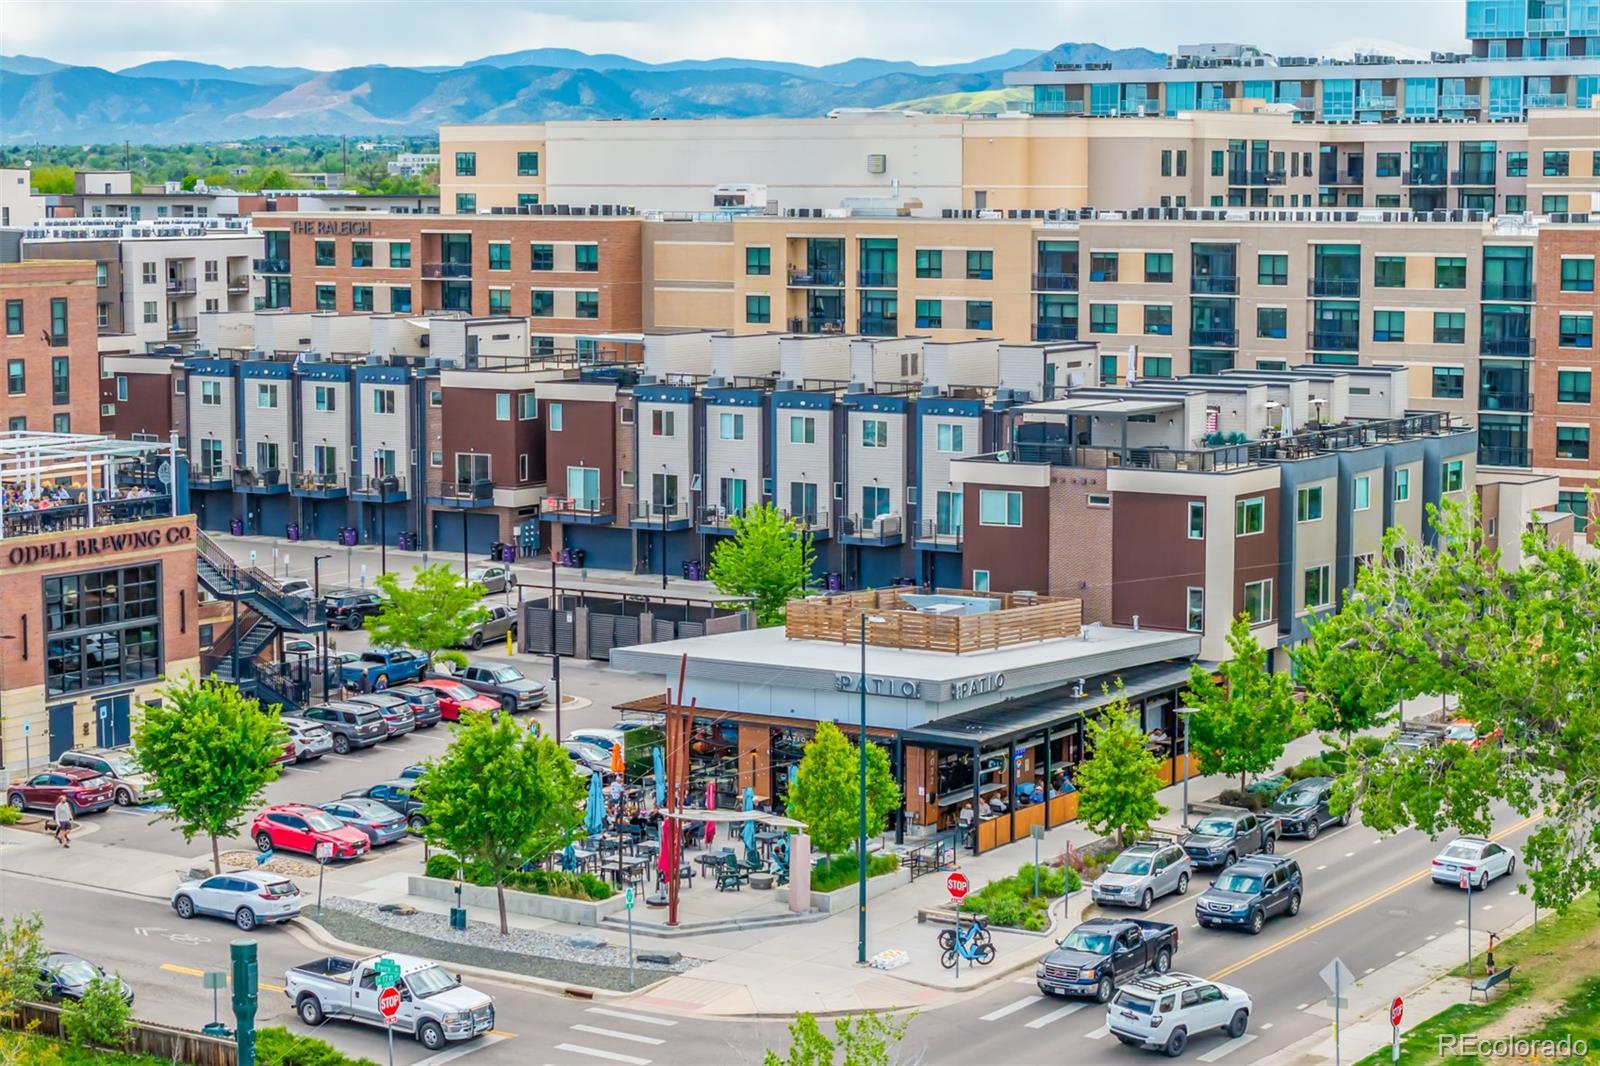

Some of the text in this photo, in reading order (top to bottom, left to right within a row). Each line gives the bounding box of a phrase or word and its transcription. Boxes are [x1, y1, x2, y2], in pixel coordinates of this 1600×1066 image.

[291, 221, 372, 236] THE RALEIGH
[9, 541, 71, 565] ODELL
[76, 529, 160, 556] BREWING
[840, 674, 916, 697] PATIO
[961, 672, 1006, 699] PATIO
[948, 879, 967, 890] STOP
[380, 994, 399, 1010] STOP
